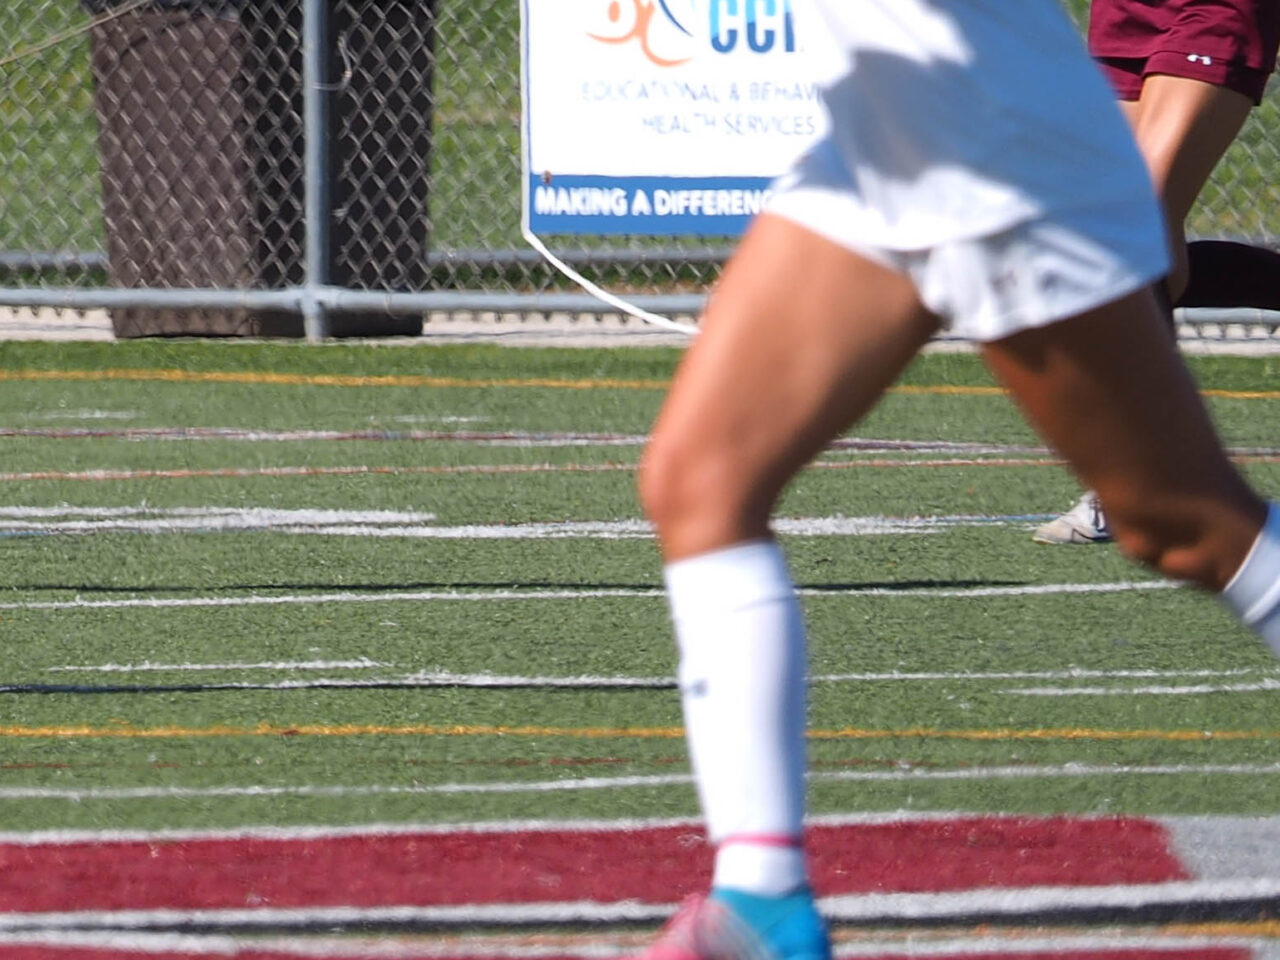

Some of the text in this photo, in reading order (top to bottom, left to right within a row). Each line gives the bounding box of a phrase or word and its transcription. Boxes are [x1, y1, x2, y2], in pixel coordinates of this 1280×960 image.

[729, 82, 741, 102] &
[641, 112, 816, 135] HEALTH SERVICES
[534, 185, 627, 216] MAKING
[631, 188, 652, 216] A
